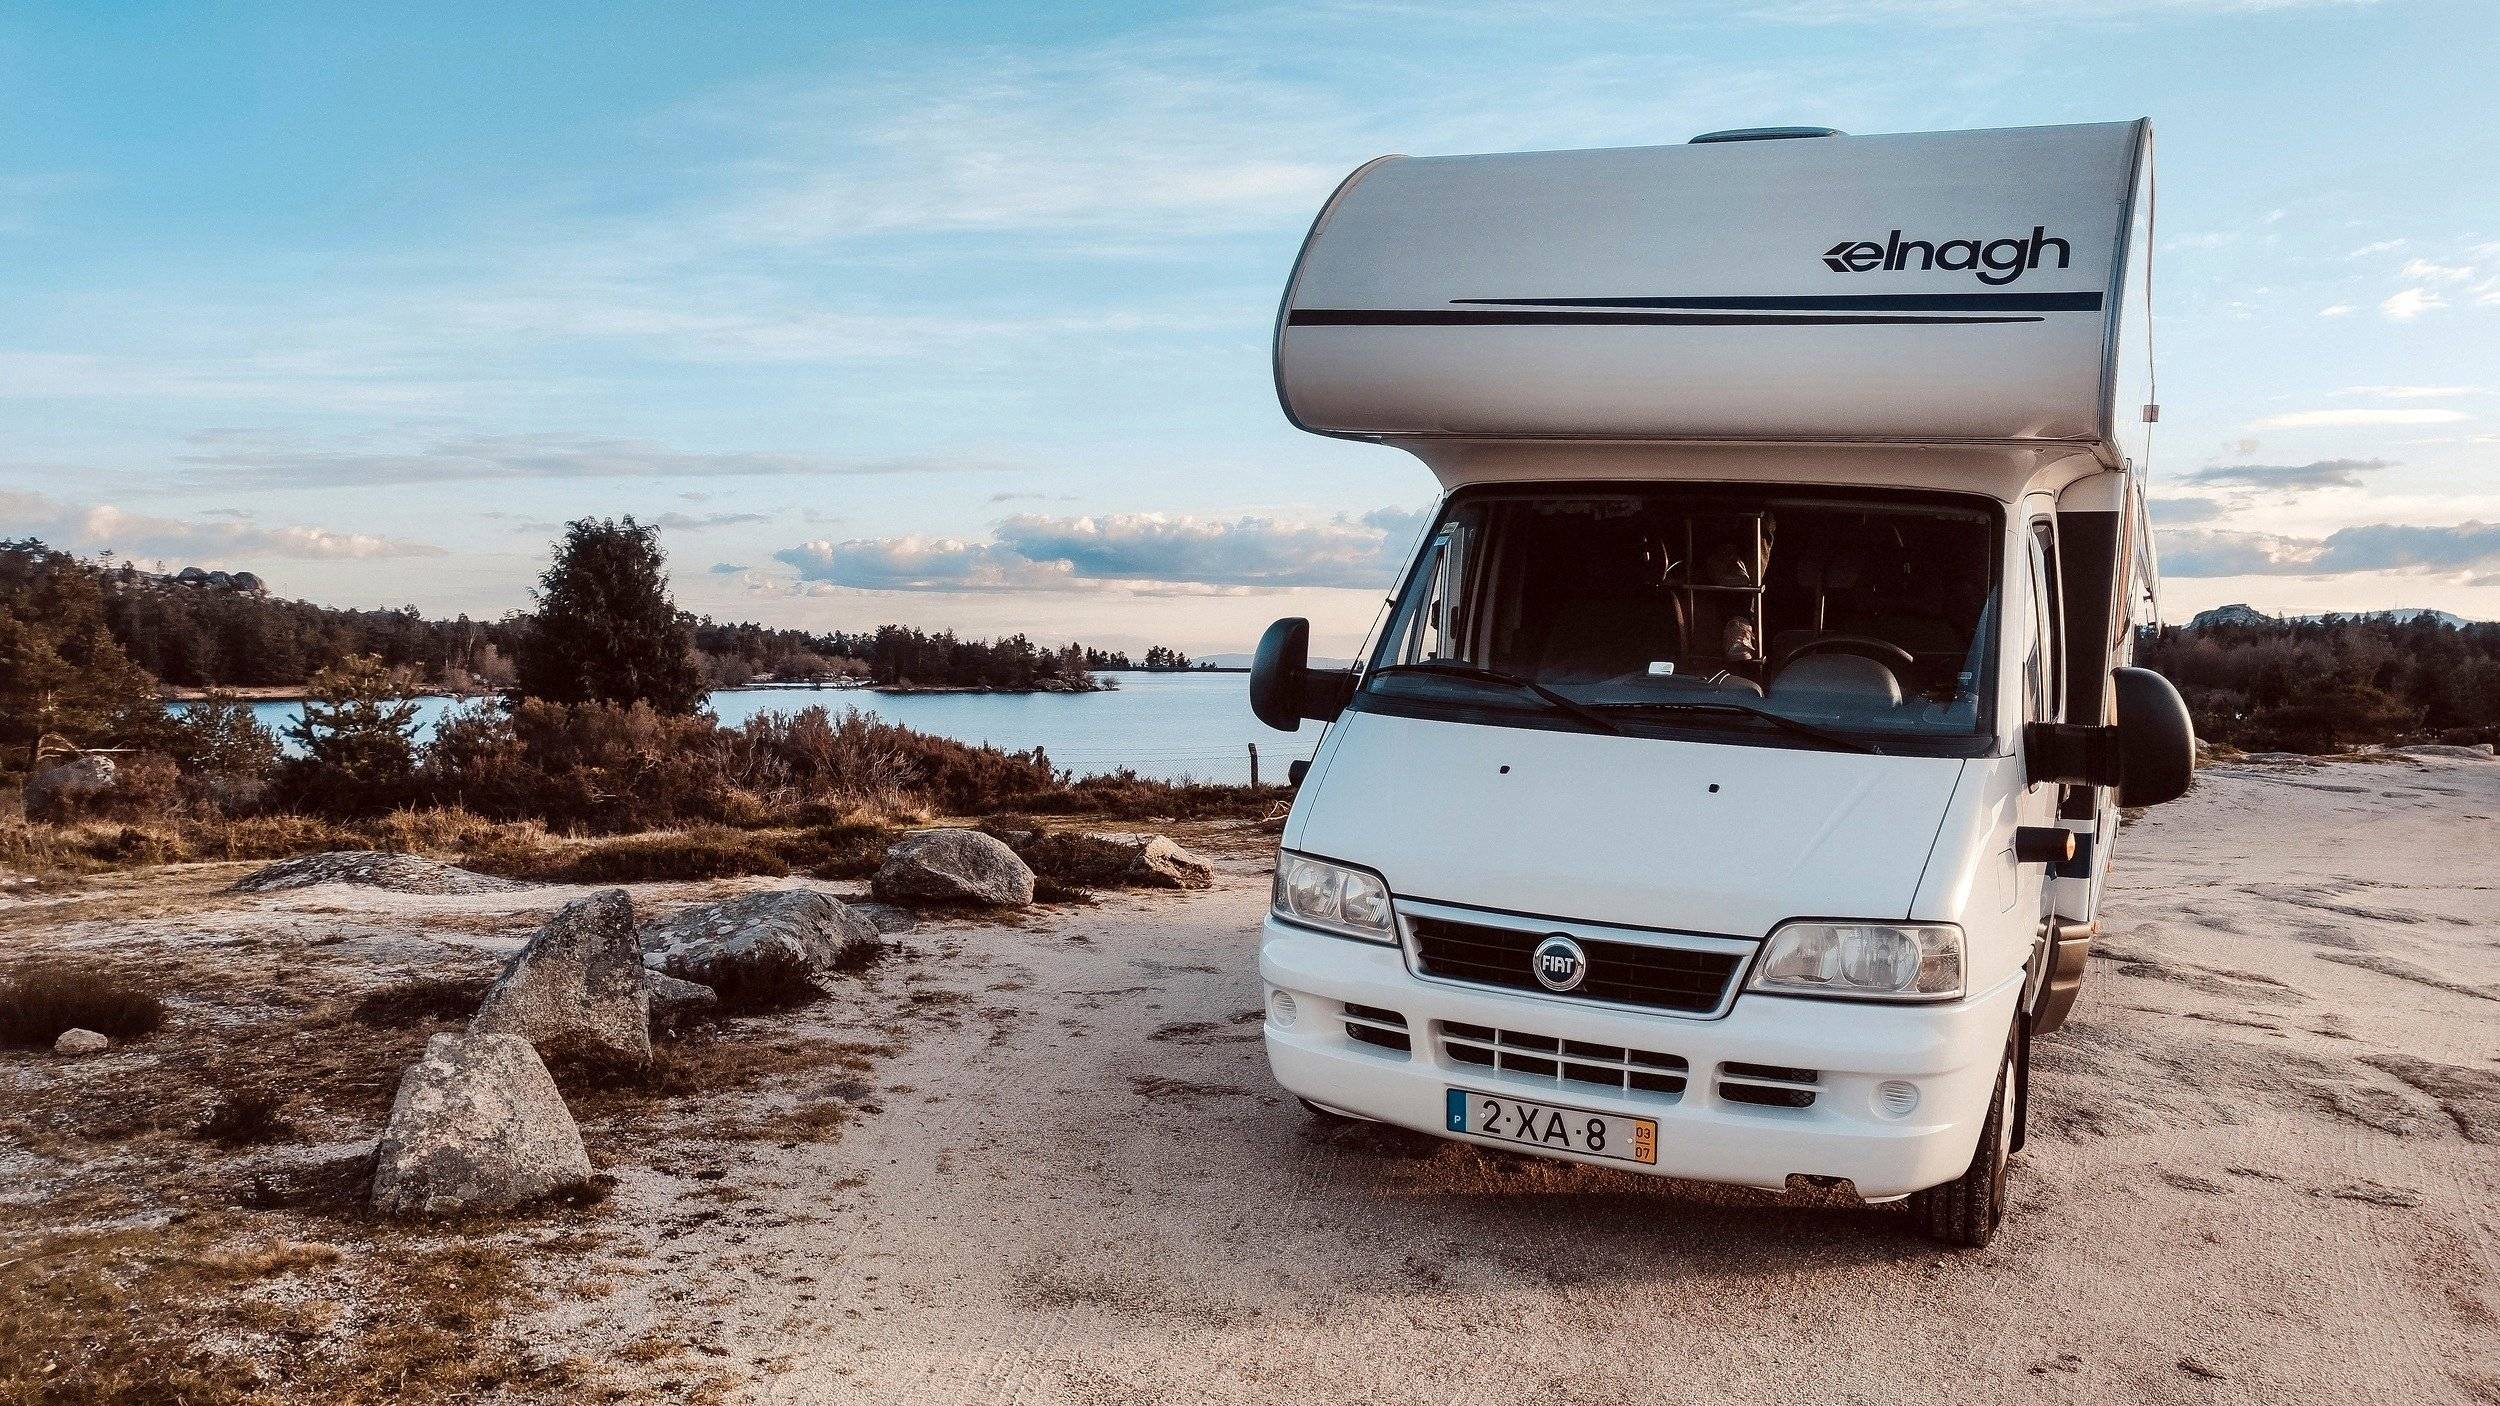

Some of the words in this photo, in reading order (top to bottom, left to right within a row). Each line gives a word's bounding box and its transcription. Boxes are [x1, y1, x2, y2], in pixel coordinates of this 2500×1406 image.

[1841, 226, 2071, 285] elnagh
[1542, 955, 1574, 974] FIAT
[1454, 1115, 1461, 1124] P
[1636, 1126, 1651, 1139] 03
[1635, 1146, 1651, 1159] 07
